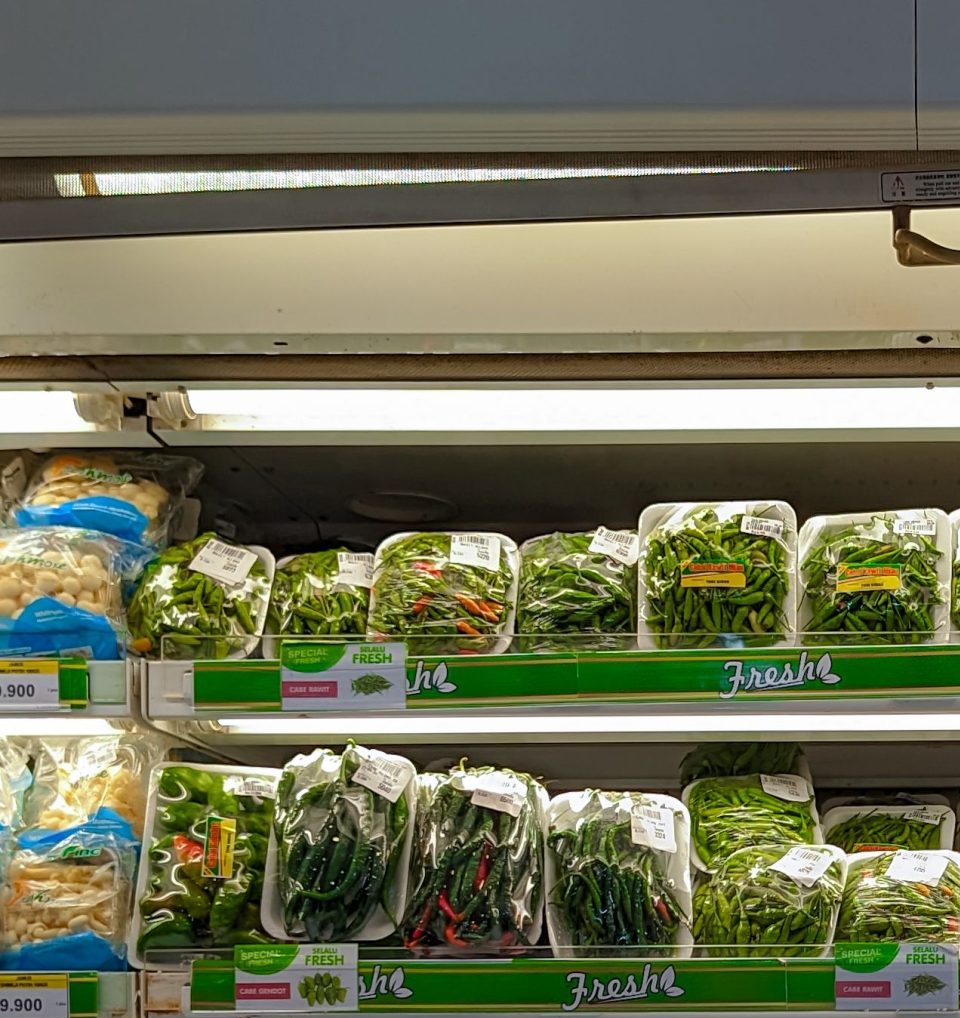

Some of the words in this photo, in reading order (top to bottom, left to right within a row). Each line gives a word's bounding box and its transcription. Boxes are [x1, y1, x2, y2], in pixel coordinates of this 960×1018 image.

[288, 648, 328, 659] SPECIAL
[352, 653, 392, 664] FRESH
[719, 651, 815, 698] Fresh
[241, 950, 280, 960] SPECIAL
[305, 955, 344, 965] FRESH
[905, 954, 945, 965] FRESH
[562, 963, 658, 1011] Fresh
